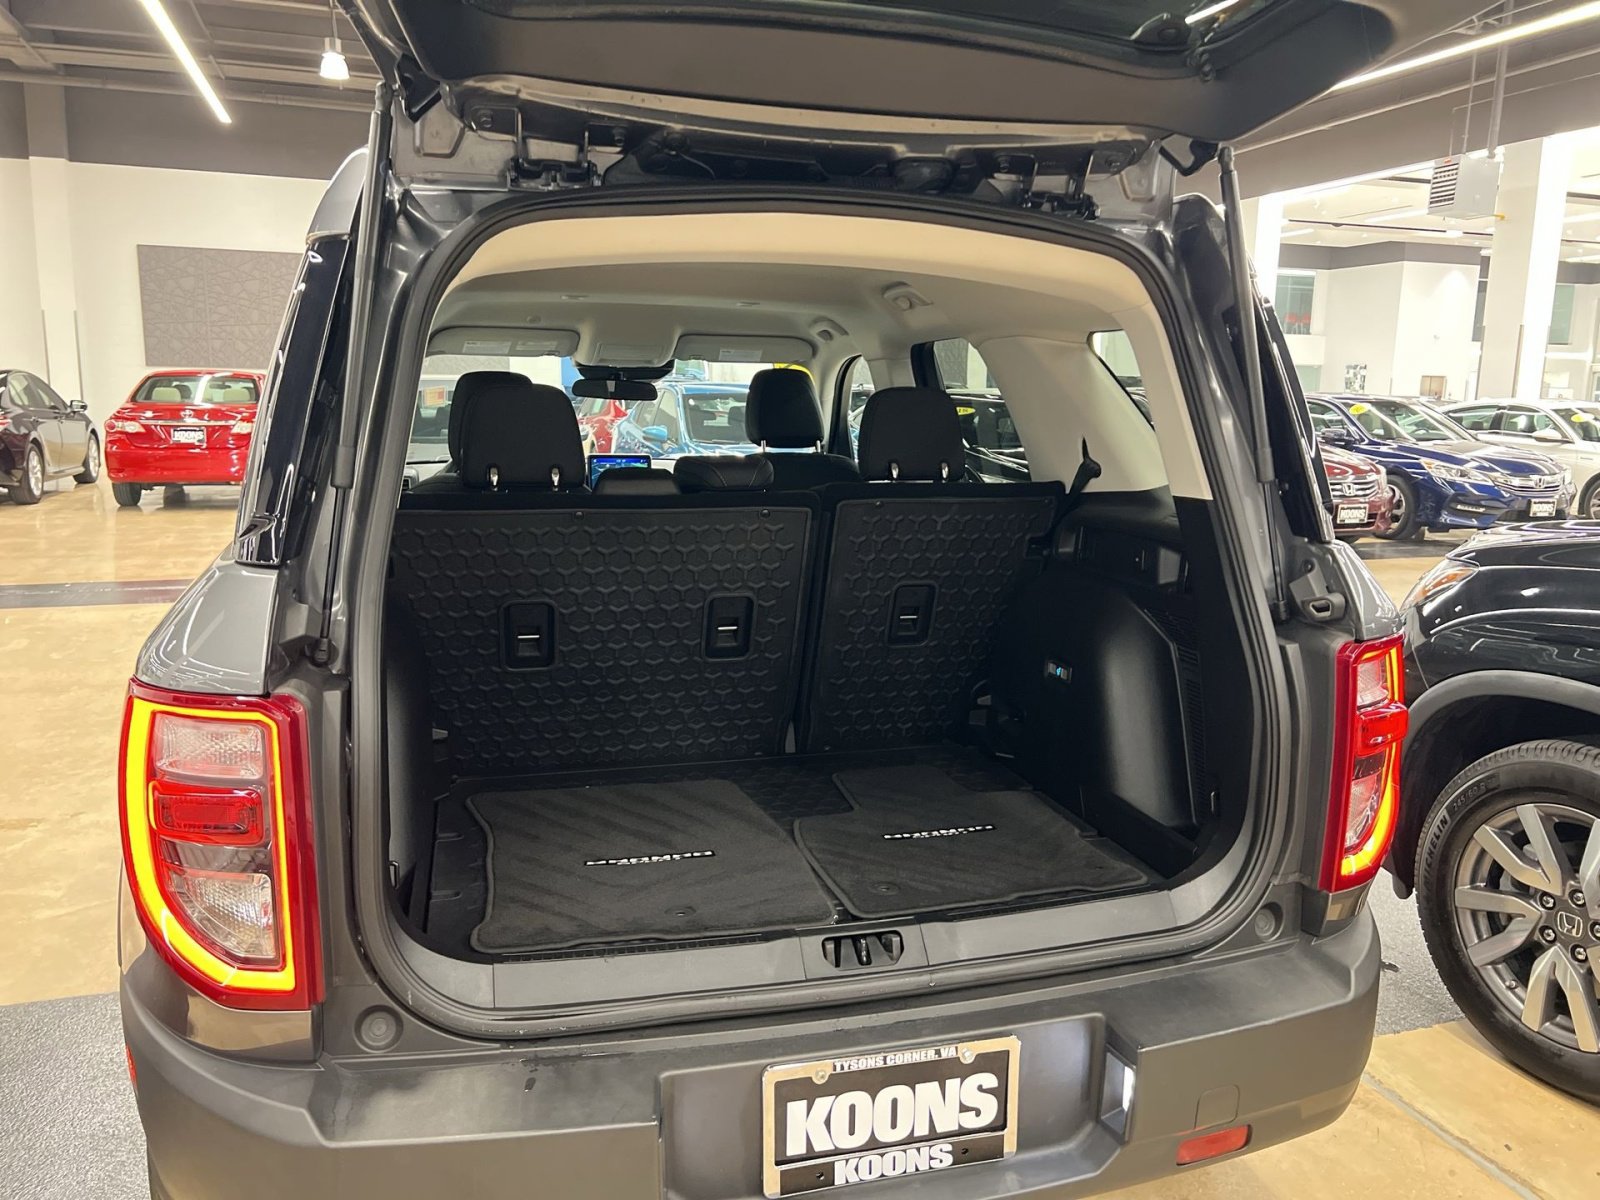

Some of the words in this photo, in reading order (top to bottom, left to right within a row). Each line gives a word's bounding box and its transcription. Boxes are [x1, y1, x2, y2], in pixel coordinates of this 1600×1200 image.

[1340, 509, 1366, 519] KOONS
[833, 1056, 885, 1073] TYSONS
[940, 1045, 958, 1059] VA
[786, 1072, 999, 1156] KOONS
[834, 1143, 954, 1186] KOONS
